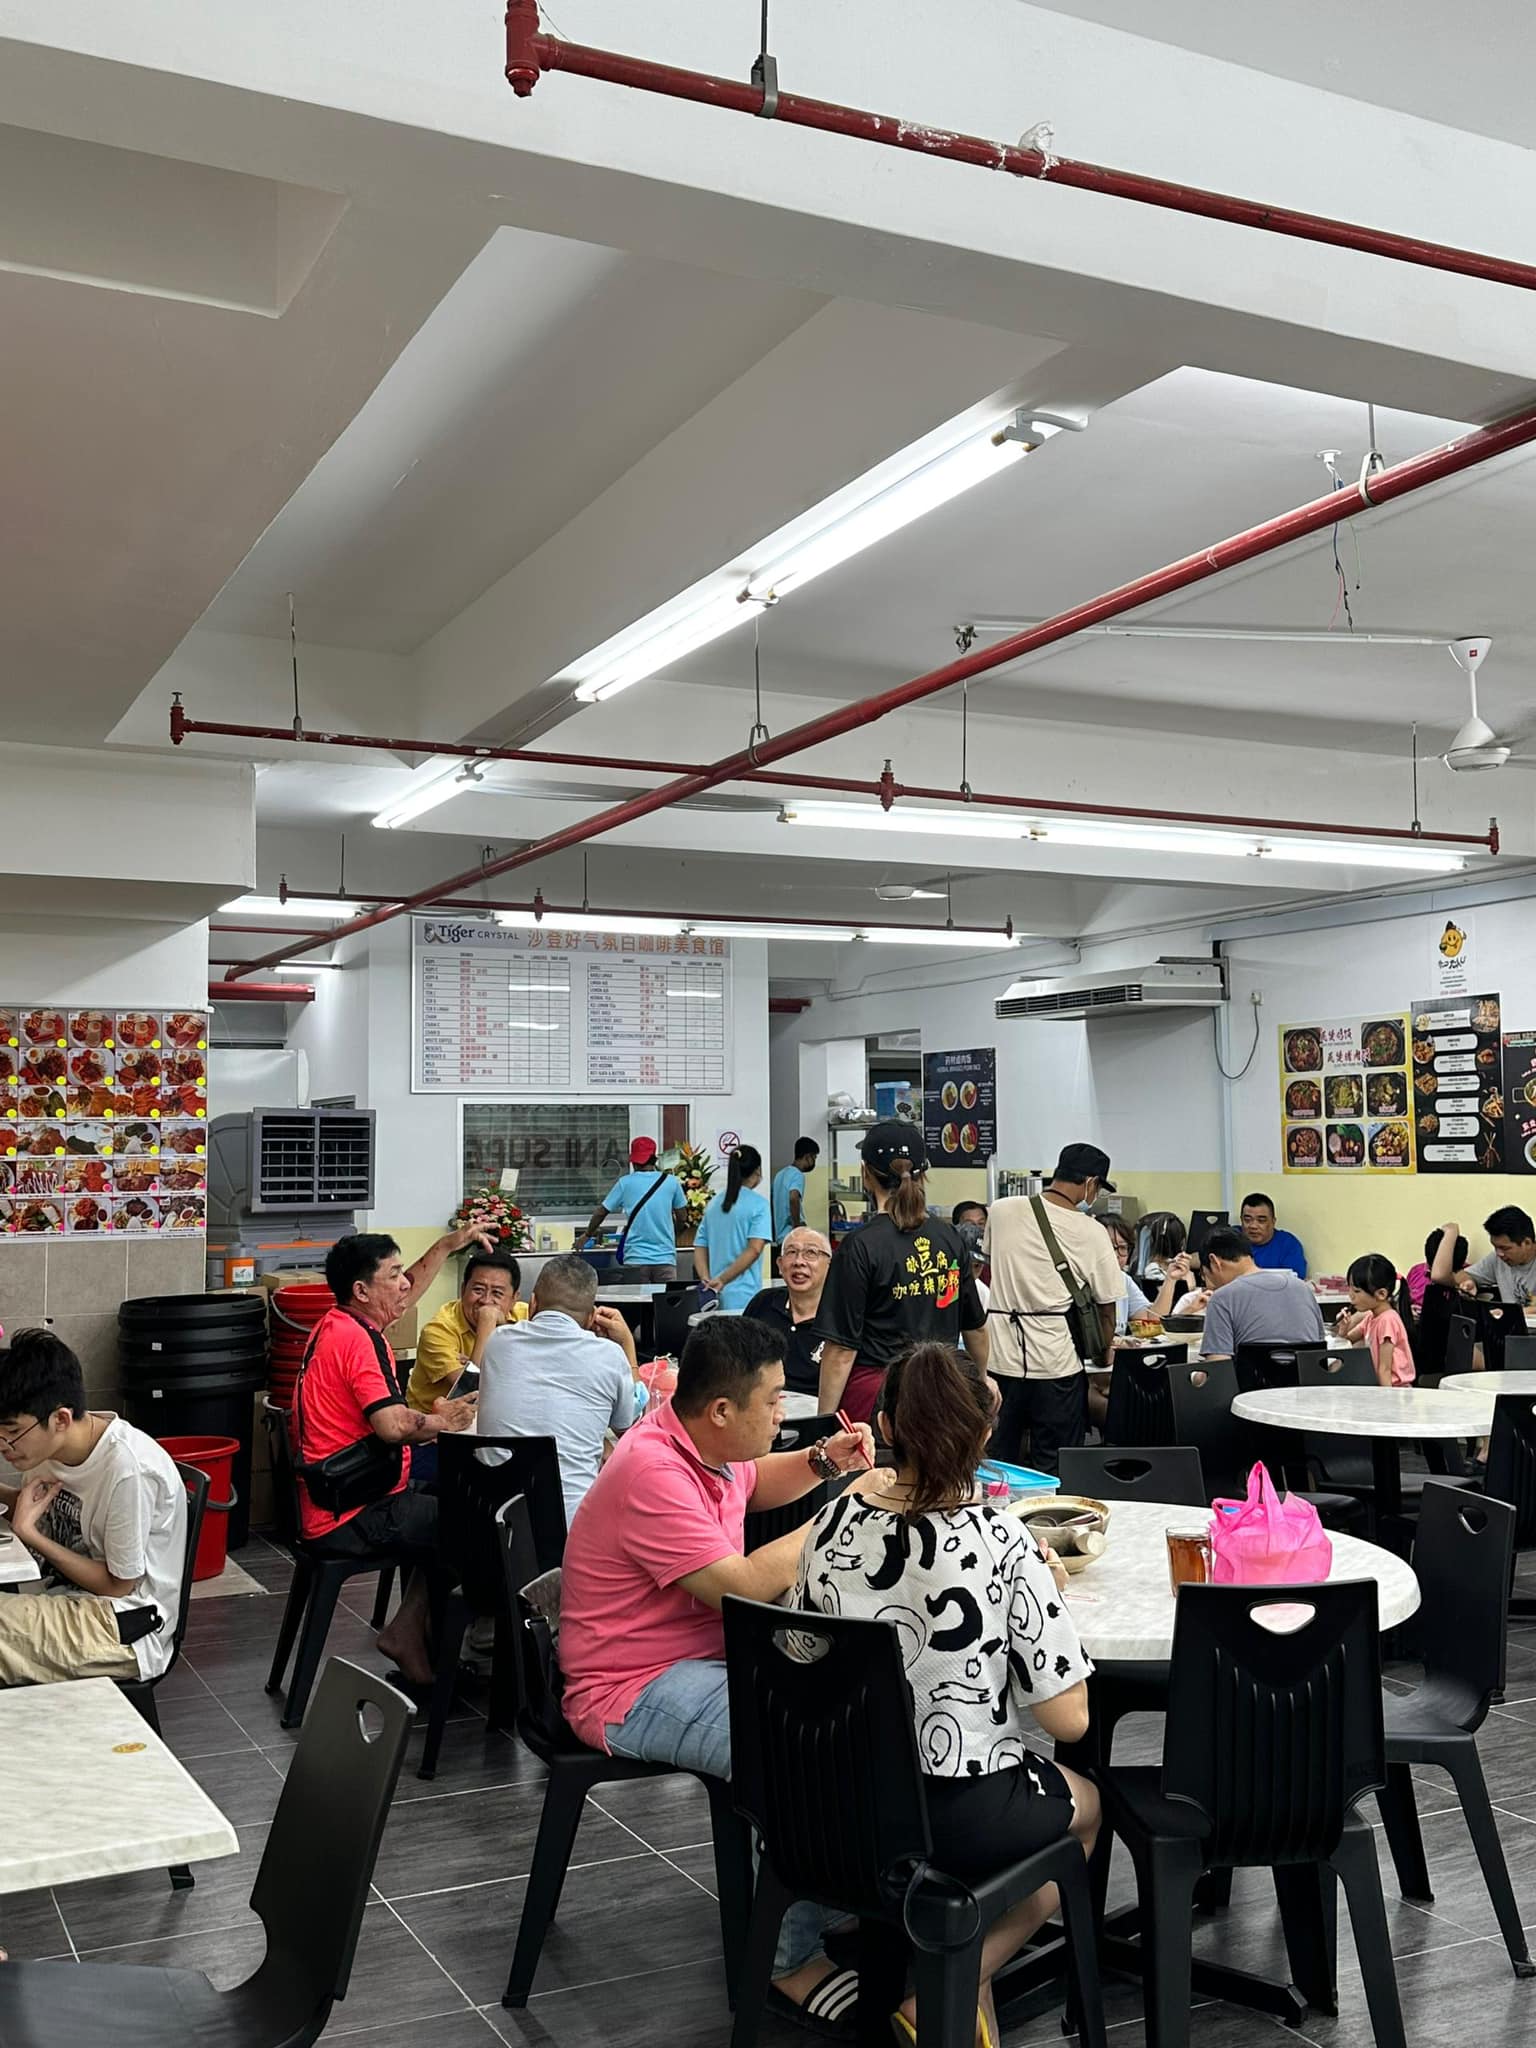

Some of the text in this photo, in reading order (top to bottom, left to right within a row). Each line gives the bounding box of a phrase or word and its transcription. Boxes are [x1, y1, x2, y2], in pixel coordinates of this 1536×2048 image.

[437, 923, 520, 943] Tiger CRYSTAL
[528, 929, 725, 955] 沙登好气氛白咖啡美食馆
